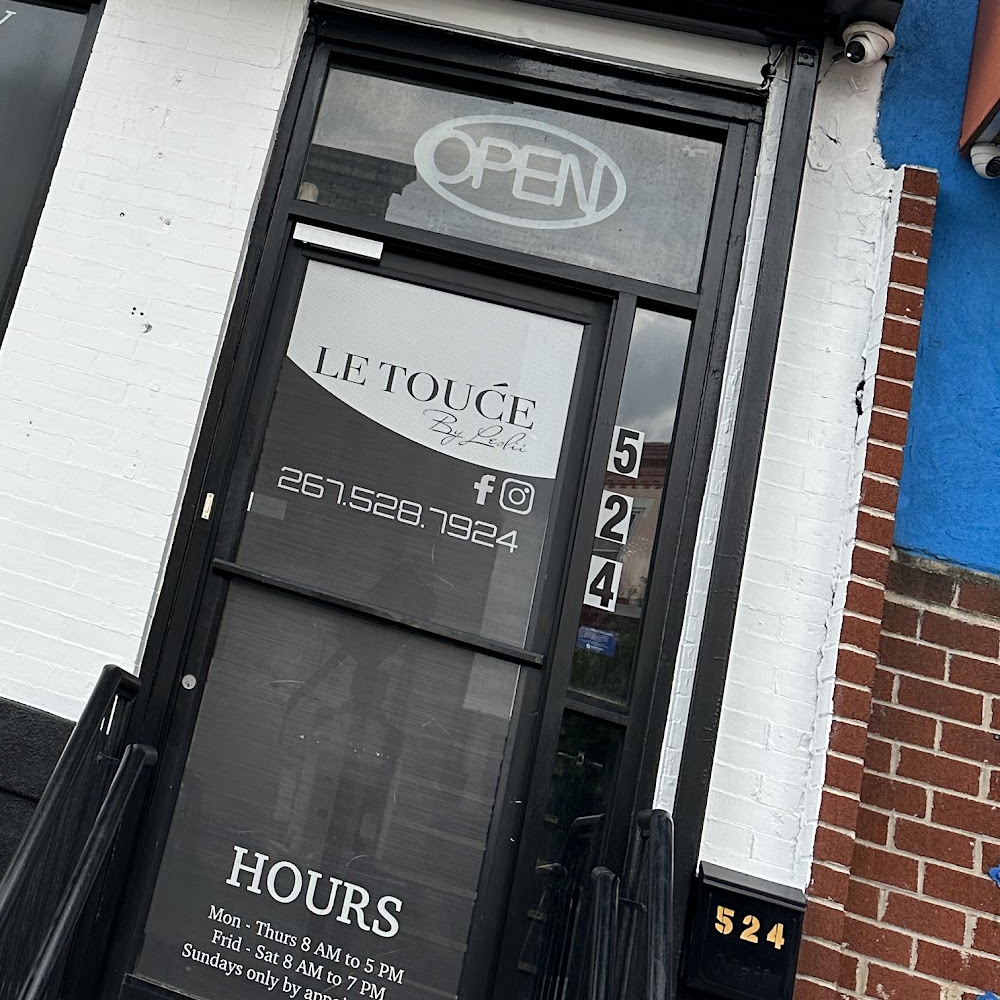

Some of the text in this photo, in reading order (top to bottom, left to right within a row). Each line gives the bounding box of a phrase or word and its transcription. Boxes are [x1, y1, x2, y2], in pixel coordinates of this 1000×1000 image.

[425, 129, 605, 214] OPEN
[312, 345, 369, 386] LE
[422, 408, 463, 446] By
[277, 465, 518, 553] 267.528.7924
[226, 845, 403, 938] HOURS
[714, 905, 785, 950] 524
[181, 943, 244, 977] Sundays
[246, 968, 280, 991] only
[282, 976, 302, 998] by
[207, 904, 241, 929] Mon
[255, 920, 298, 948] Thurs
[300, 936, 312, 952] 8
[313, 941, 342, 963] AM
[345, 952, 361, 970] to
[363, 957, 376, 974] 5
[377, 962, 405, 985] PM
[210, 928, 243, 952] Frid
[254, 943, 280, 965] Sat
[282, 953, 294, 970] 8
[295, 960, 324, 981] AM
[326, 969, 342, 987] to
[346, 975, 358, 991] 7
[359, 980, 387, 1000] PM
